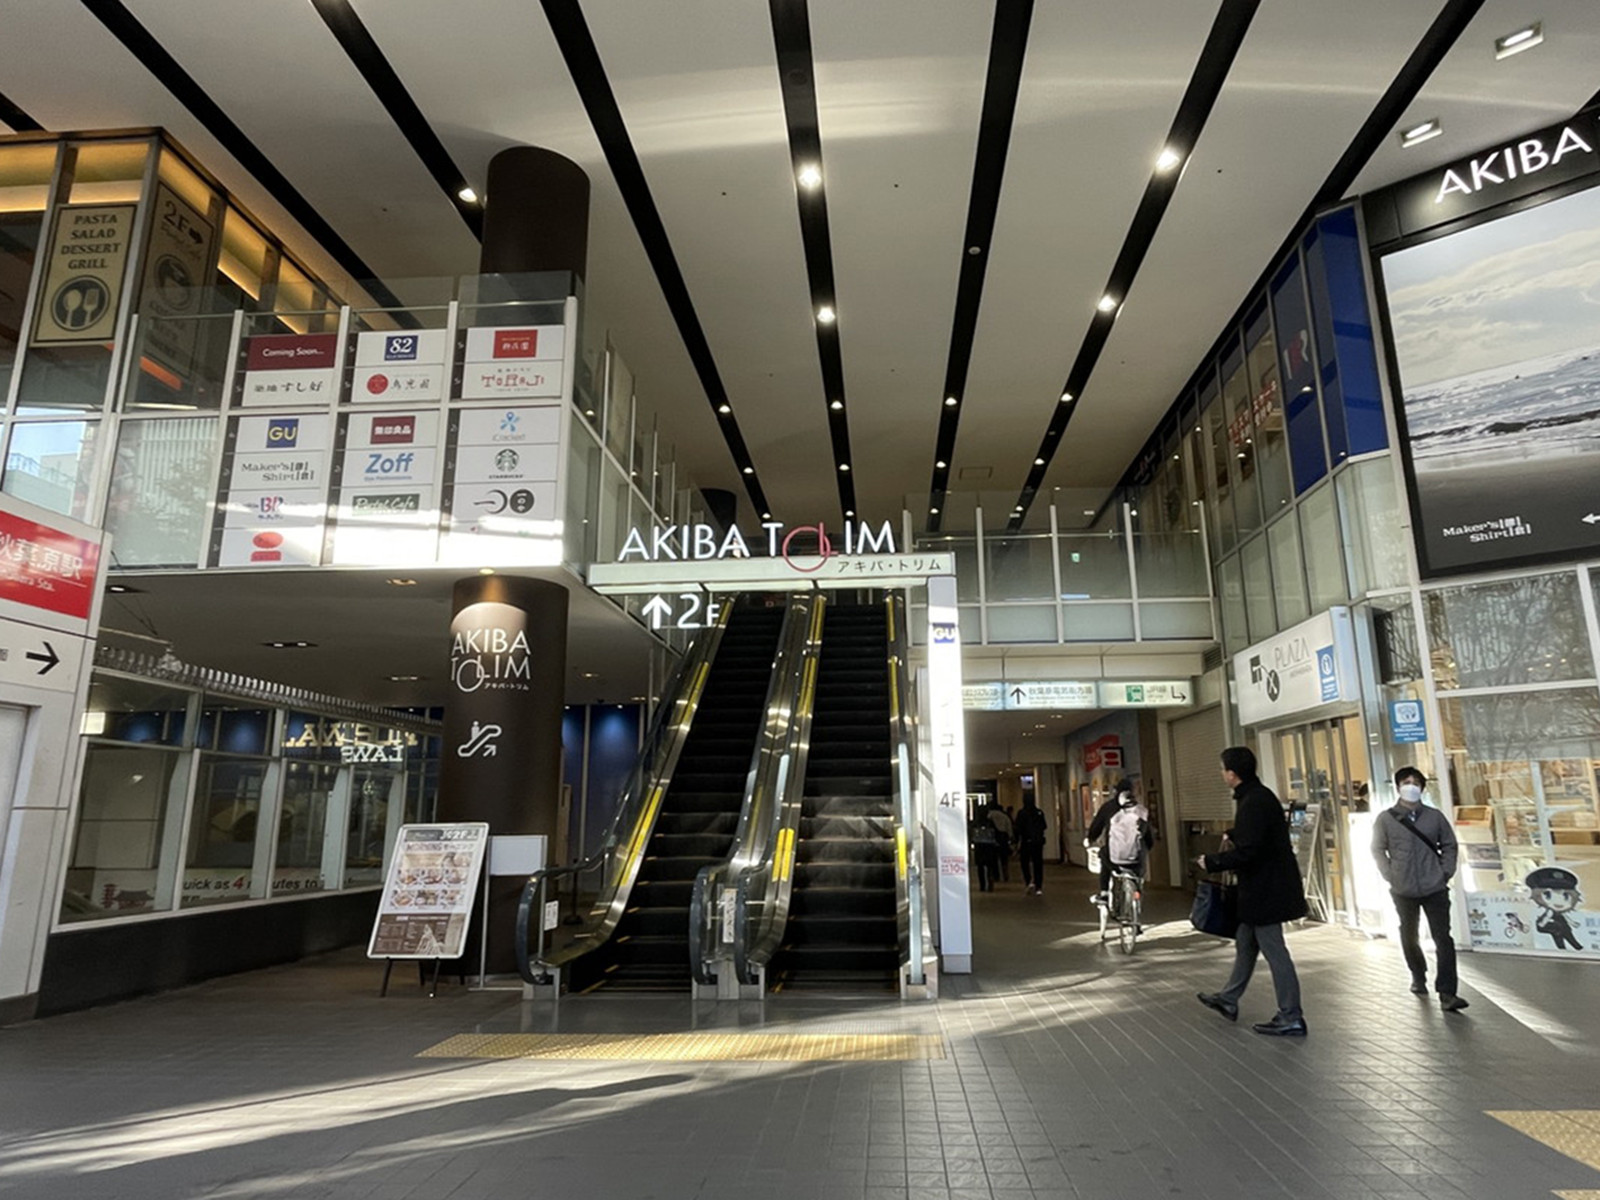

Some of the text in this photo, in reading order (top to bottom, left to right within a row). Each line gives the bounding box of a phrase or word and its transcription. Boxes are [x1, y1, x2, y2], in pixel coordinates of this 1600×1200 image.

[1435, 127, 1592, 203] AKIBA
[74, 214, 118, 225] PASTA
[163, 201, 189, 233] 2F
[71, 229, 116, 240] SALAD
[60, 243, 121, 255] DESSERT
[68, 258, 109, 270] GRILL
[262, 348, 295, 358] Coming
[389, 337, 413, 354] 82
[269, 426, 297, 441] GU
[365, 453, 414, 474] Zoff
[1443, 521, 1499, 537] Maker's
[1469, 530, 1509, 543] Shirt
[617, 523, 750, 562] AKIBA
[837, 558, 942, 574] アキバ・トリム
[677, 592, 720, 629] 2F
[934, 627, 955, 640] GU
[451, 628, 531, 656] AKIBA
[1274, 637, 1310, 669] PLAZA
[939, 791, 961, 808] 4F
[182, 878, 211, 890] uick
[214, 880, 230, 890] as
[232, 876, 245, 890] 4
